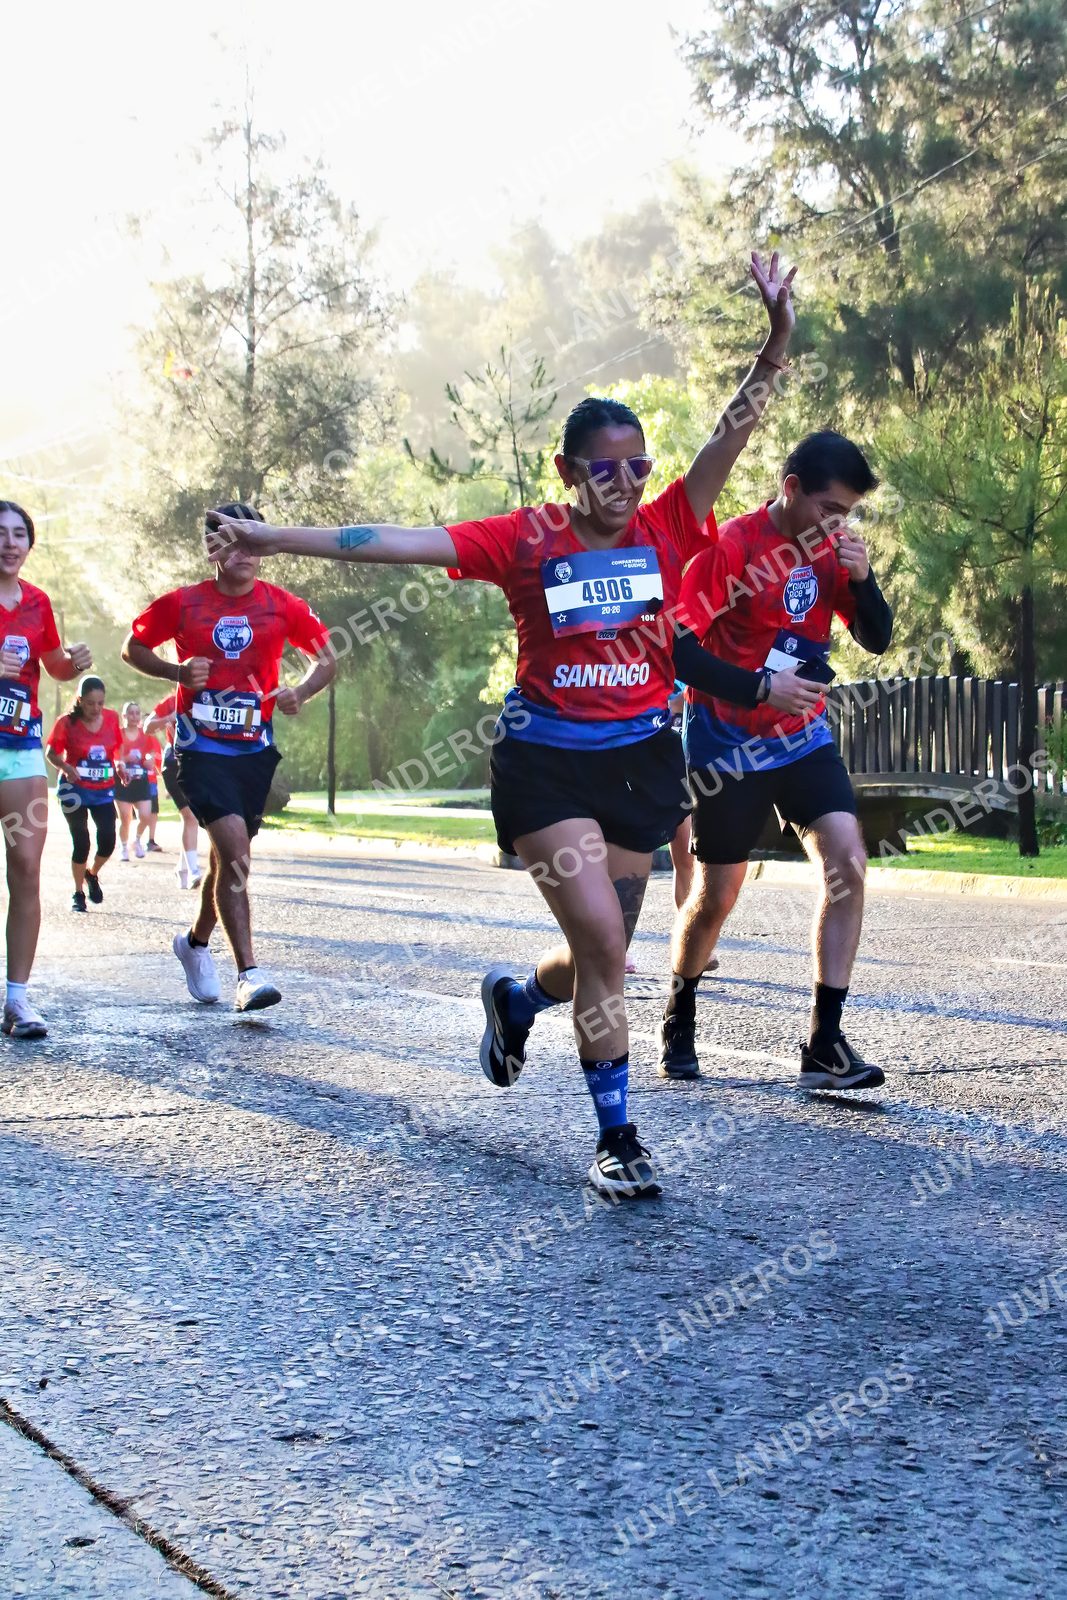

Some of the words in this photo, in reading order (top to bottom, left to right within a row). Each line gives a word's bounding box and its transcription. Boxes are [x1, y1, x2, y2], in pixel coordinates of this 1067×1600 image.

[582, 578, 633, 604] 4906
[640, 614, 656, 622] 10K
[597, 631, 616, 639] 2026
[553, 662, 650, 689] SANTIAGO
[213, 708, 241, 723] 4031
